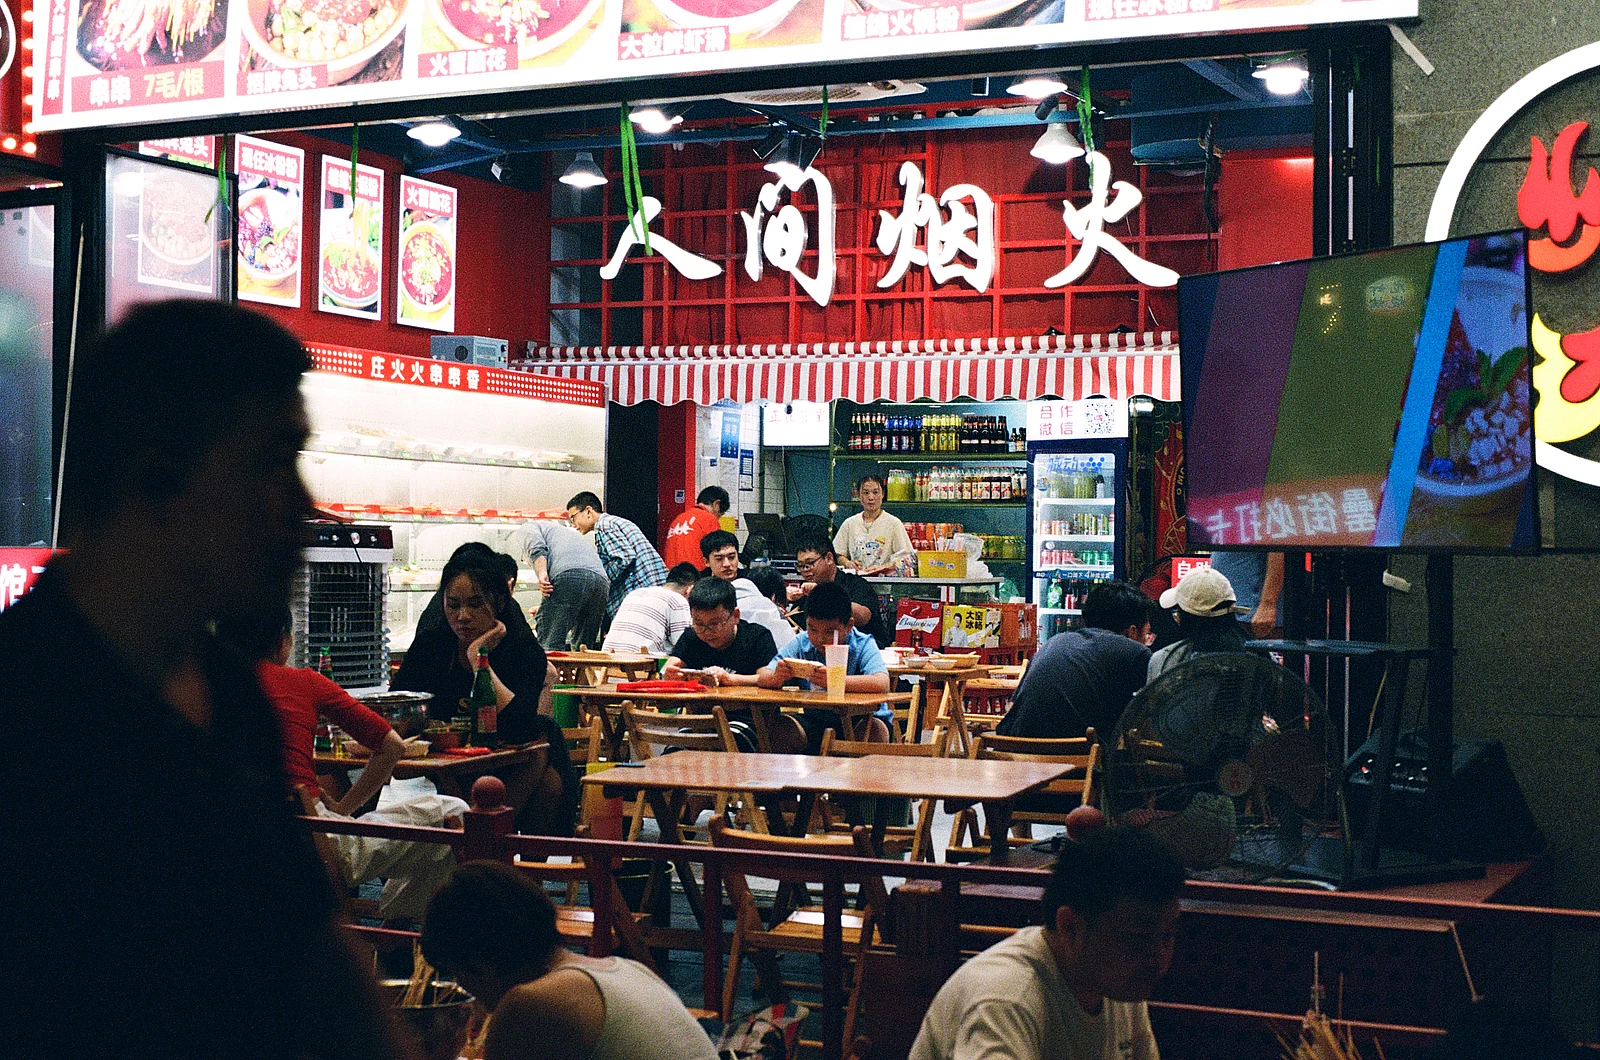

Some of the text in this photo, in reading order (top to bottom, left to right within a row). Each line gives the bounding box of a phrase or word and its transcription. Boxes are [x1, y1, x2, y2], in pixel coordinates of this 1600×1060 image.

[620, 28, 728, 60] 大粒鲜虾滑
[90, 68, 204, 107] 串串 7毛/根
[247, 68, 317, 95] 招牌兔头
[600, 152, 1181, 307] 人间烟火
[371, 356, 480, 390] 庄火火串串香
[1040, 405, 1073, 419] 合作
[1040, 421, 1073, 436] 微信
